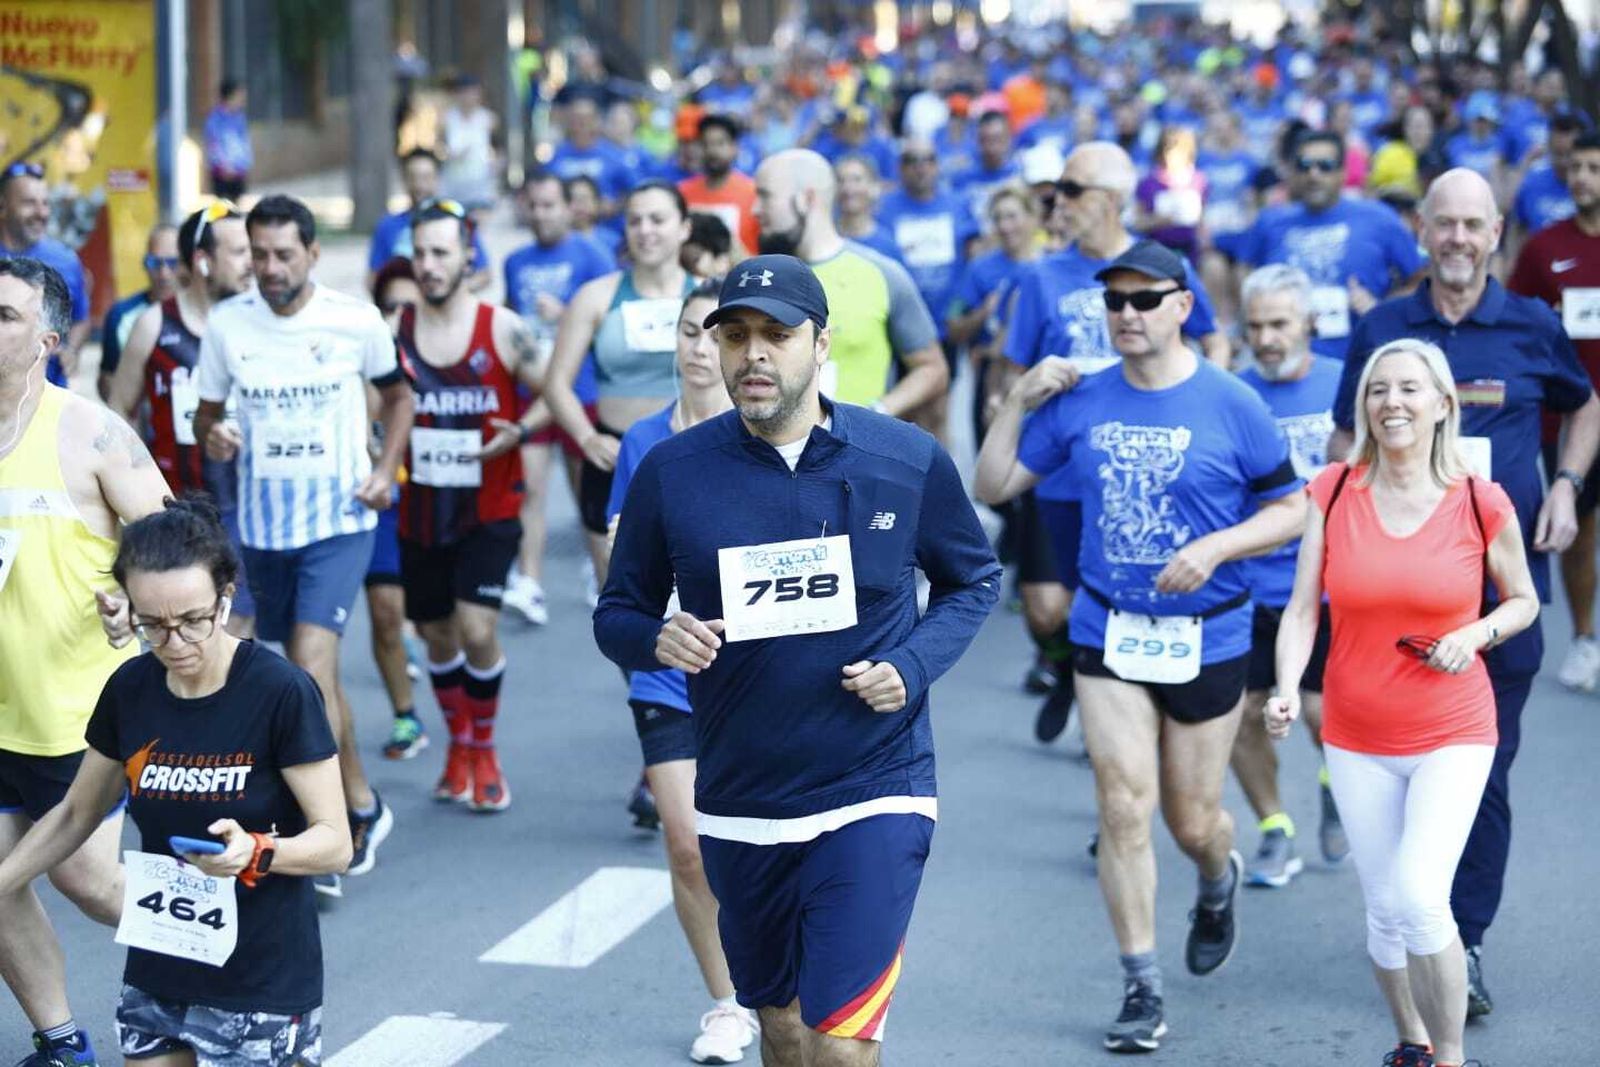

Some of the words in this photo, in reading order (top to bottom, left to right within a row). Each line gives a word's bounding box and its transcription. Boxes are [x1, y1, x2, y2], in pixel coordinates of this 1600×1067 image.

[0, 12, 98, 39] Nuevo
[266, 442, 325, 458] 325
[743, 573, 839, 606] 758
[1117, 637, 1191, 658] 299
[139, 764, 252, 793] CROSSFIT
[137, 890, 227, 930] 464
